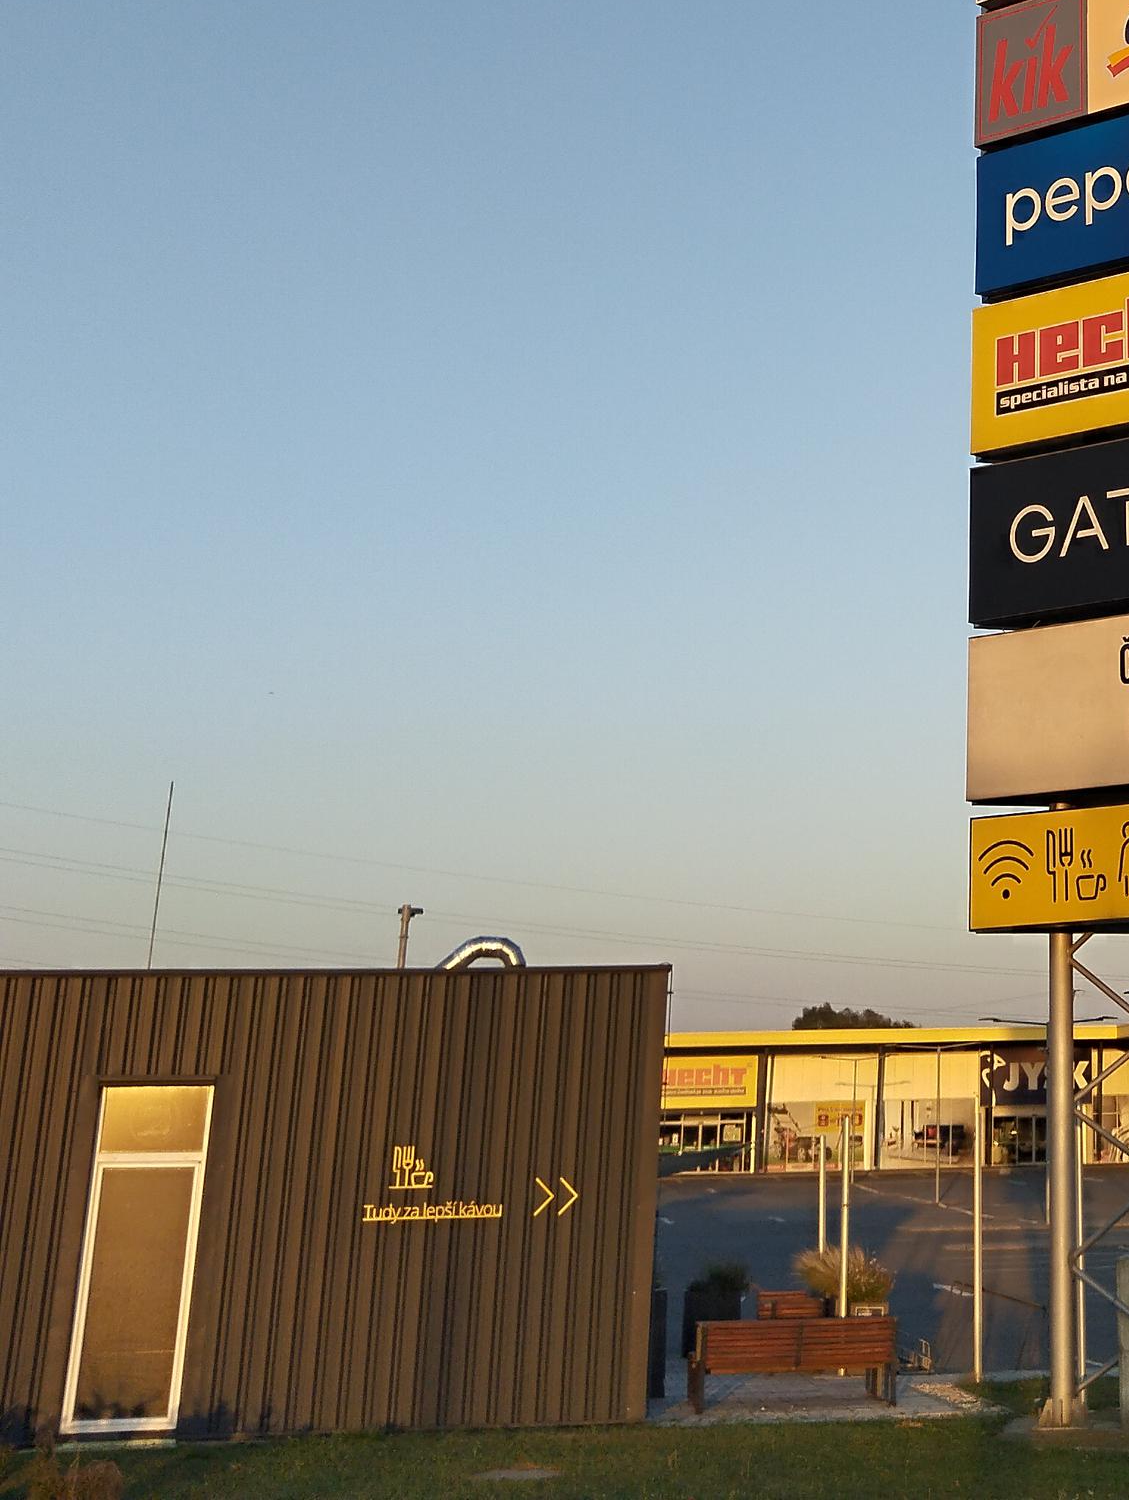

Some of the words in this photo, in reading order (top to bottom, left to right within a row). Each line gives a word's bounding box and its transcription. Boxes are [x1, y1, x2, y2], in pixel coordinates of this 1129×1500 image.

[1000, 376, 1099, 409] specialista
[1103, 372, 1127, 387] na
[1003, 1061, 1089, 1091] JYK
[364, 1203, 401, 1224] Tudy
[404, 1205, 419, 1218] za
[423, 1201, 457, 1222] lepší
[459, 1200, 503, 1217] kávou
